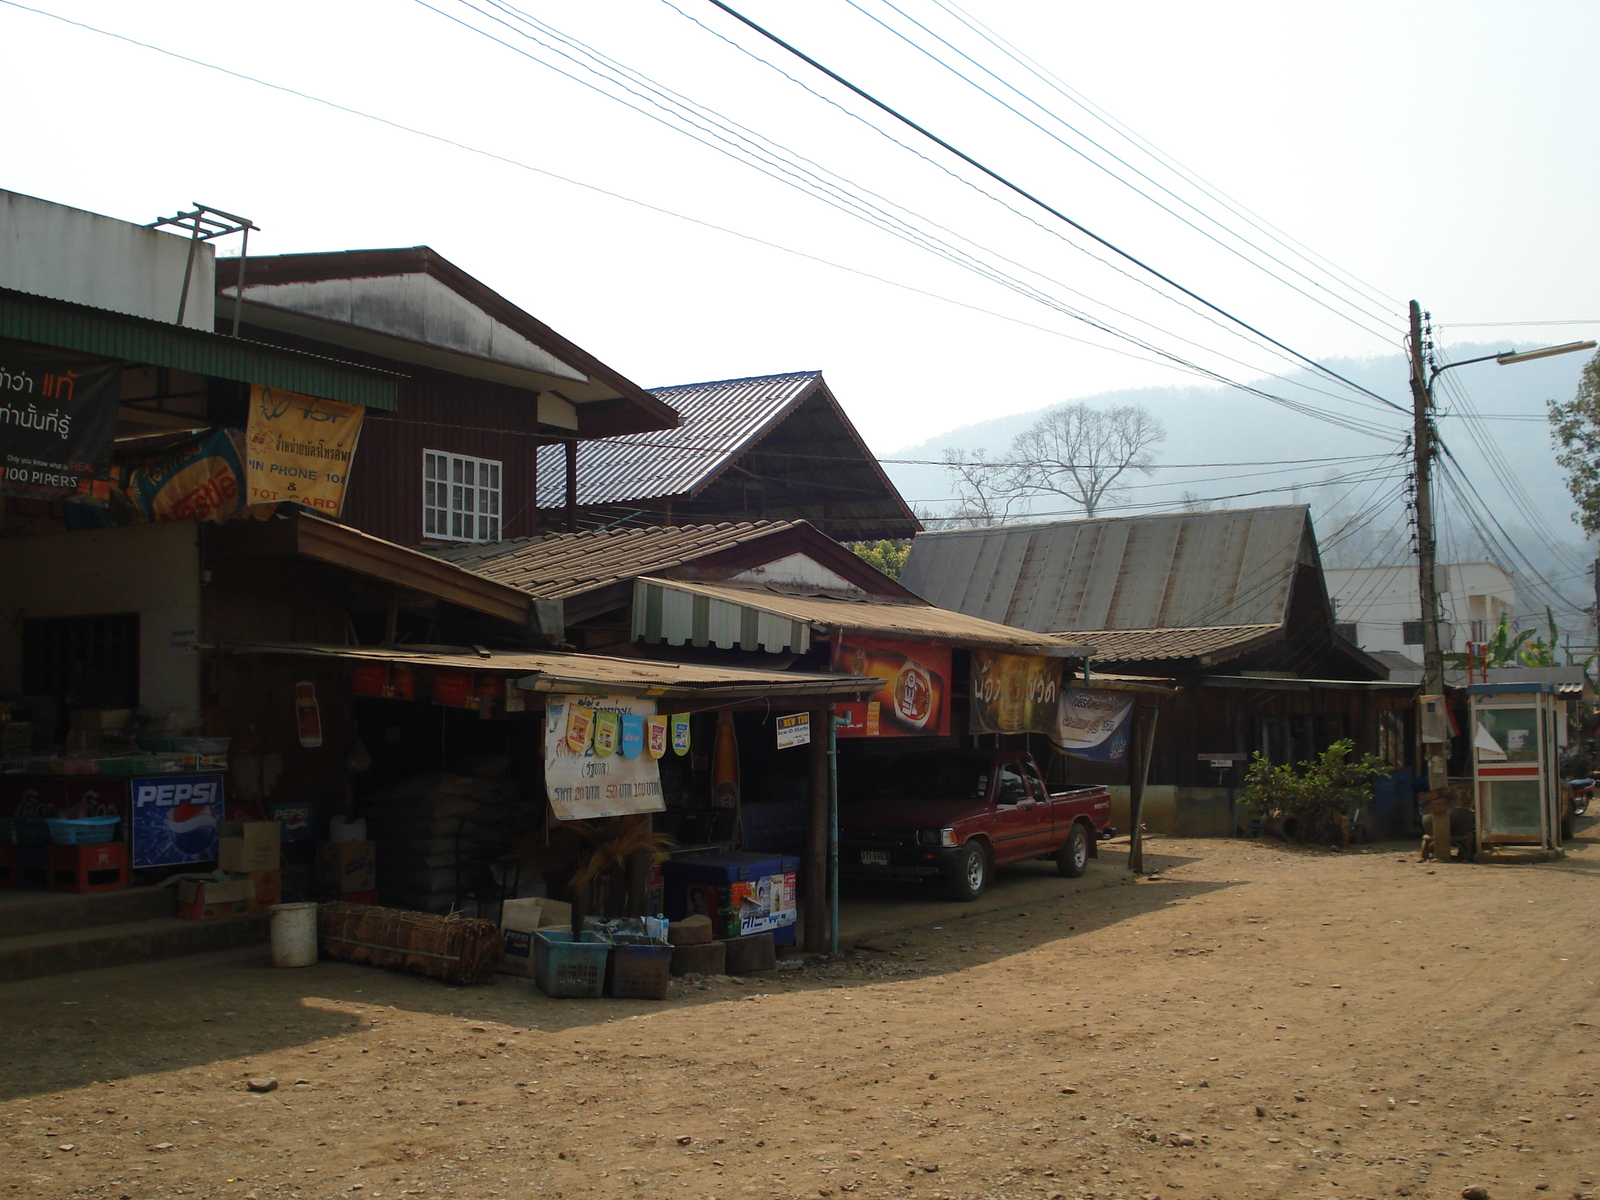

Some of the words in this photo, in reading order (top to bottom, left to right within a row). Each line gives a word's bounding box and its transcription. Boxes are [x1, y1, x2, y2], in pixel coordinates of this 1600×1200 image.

[42, 369, 78, 402] แท้
[297, 407, 347, 424] TOT
[7, 454, 20, 464] Only
[20, 456, 32, 466] you
[33, 458, 48, 468] know
[49, 460, 63, 470] what
[69, 462, 94, 473] REAL
[270, 463, 317, 481] PHONE
[5, 467, 29, 482] 100
[31, 470, 78, 488] PIPERS
[287, 481, 297, 492] &
[251, 487, 279, 500] TOT
[901, 669, 918, 716] LEO
[136, 782, 218, 808] PEPSI
[574, 786, 585, 801] 20
[606, 784, 618, 800] 50
[633, 782, 646, 798] 100
[273, 807, 309, 821] PEPSI
[505, 931, 529, 942] PEPSI
